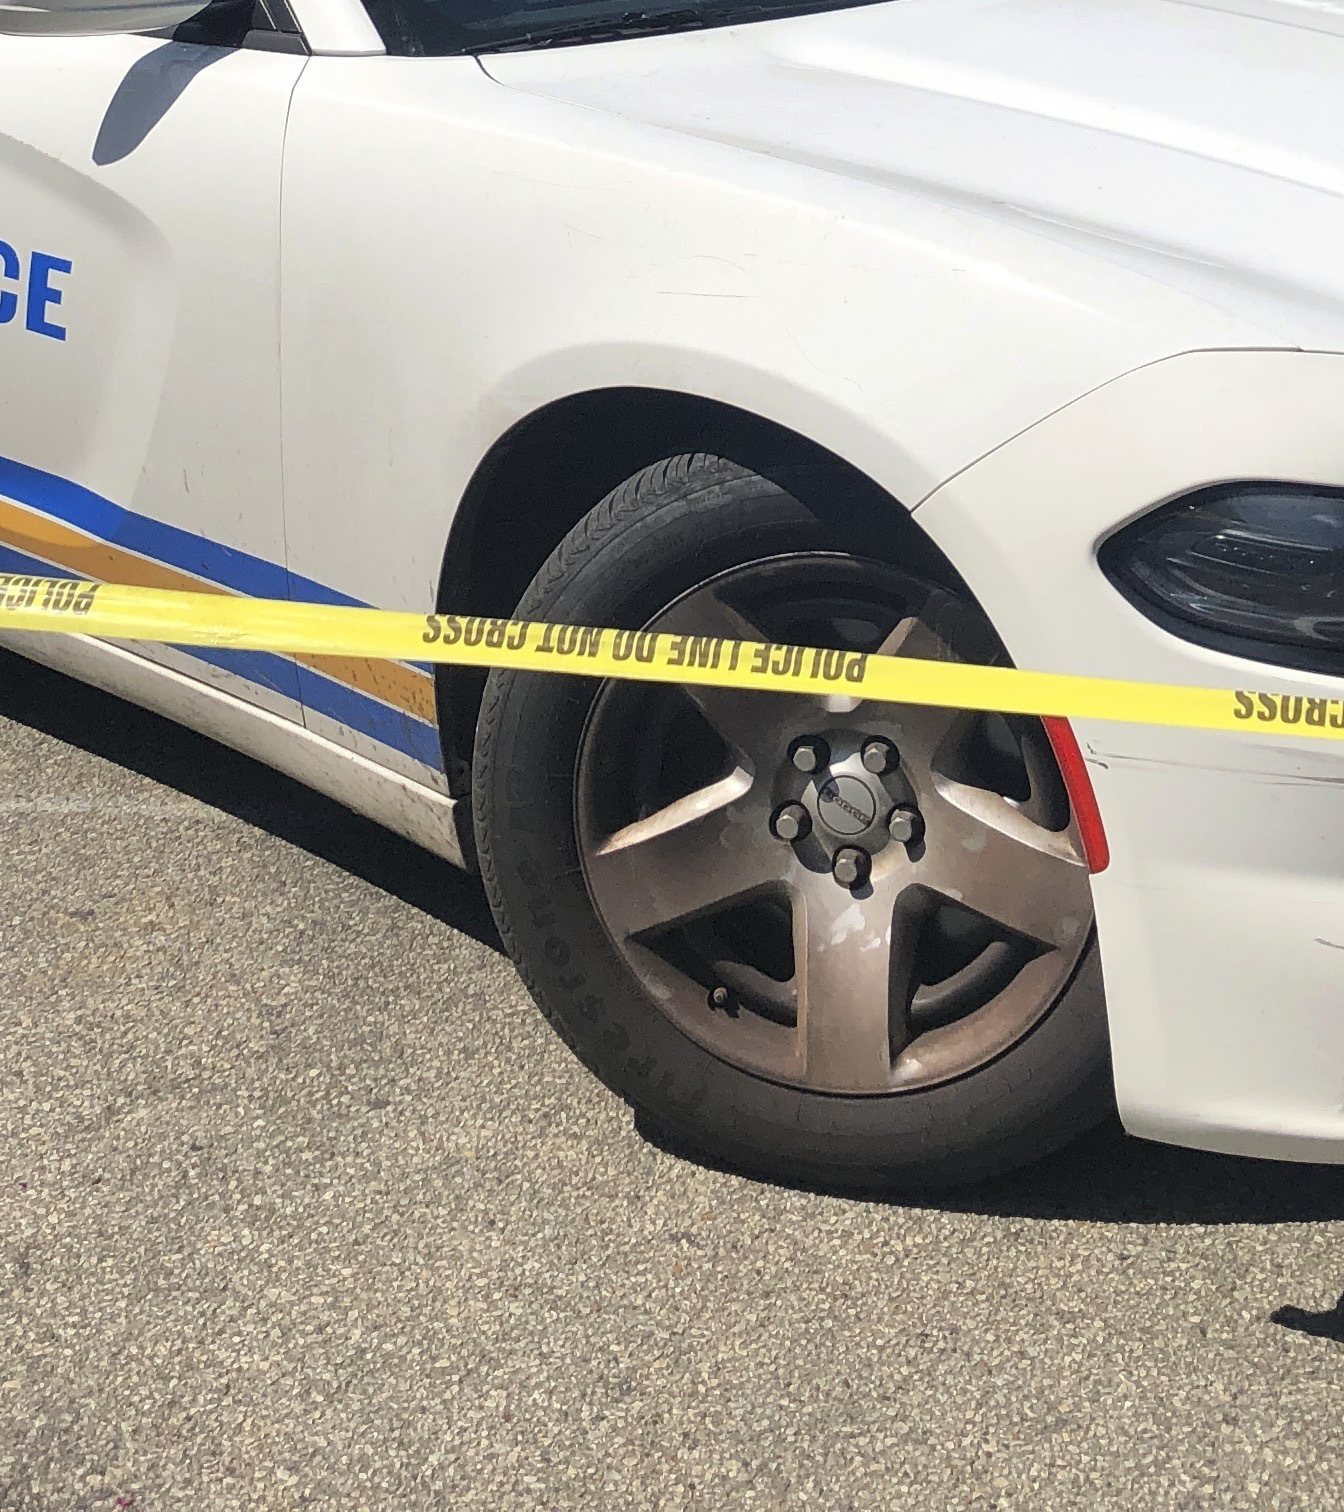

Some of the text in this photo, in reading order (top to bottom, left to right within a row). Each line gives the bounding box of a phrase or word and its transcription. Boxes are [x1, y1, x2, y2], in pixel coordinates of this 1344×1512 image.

[422, 614, 532, 650] CROSS
[535, 624, 603, 659] NOT
[611, 629, 659, 663] DO
[751, 643, 870, 683] POLICE
